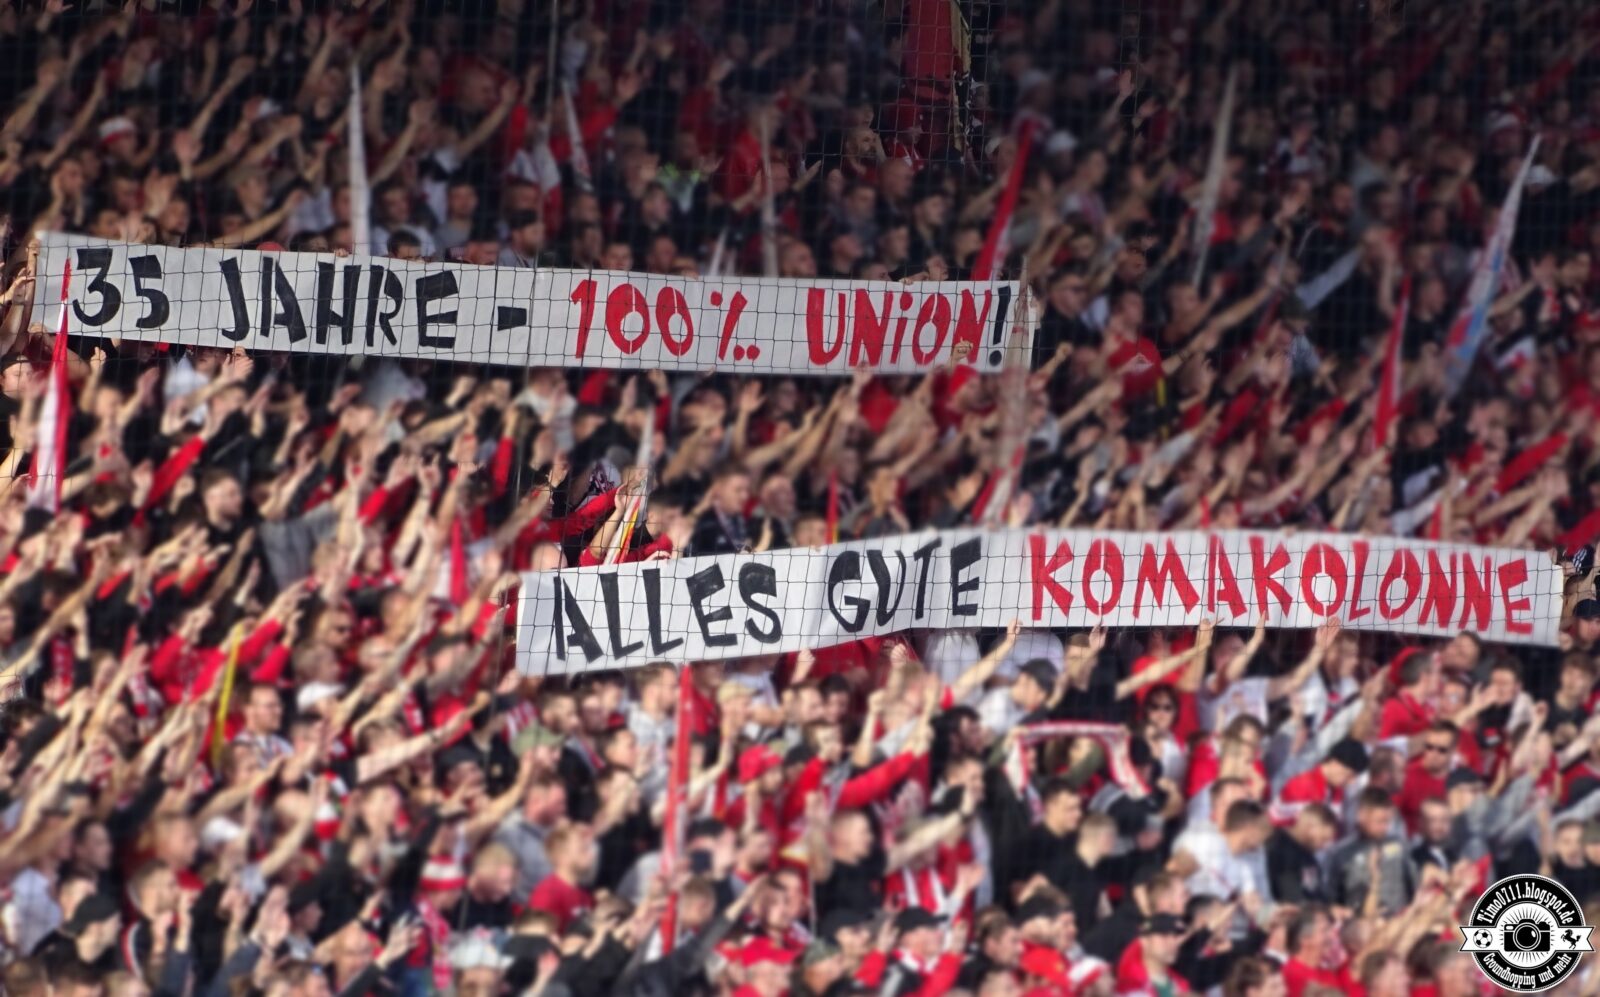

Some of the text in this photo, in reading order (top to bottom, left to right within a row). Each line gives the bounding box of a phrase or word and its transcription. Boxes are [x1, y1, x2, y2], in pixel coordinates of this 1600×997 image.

[72, 248, 170, 329] 35
[219, 256, 459, 348] JAHRE
[553, 534, 1533, 663] ALLES GUTE KOMAKOLONNE
